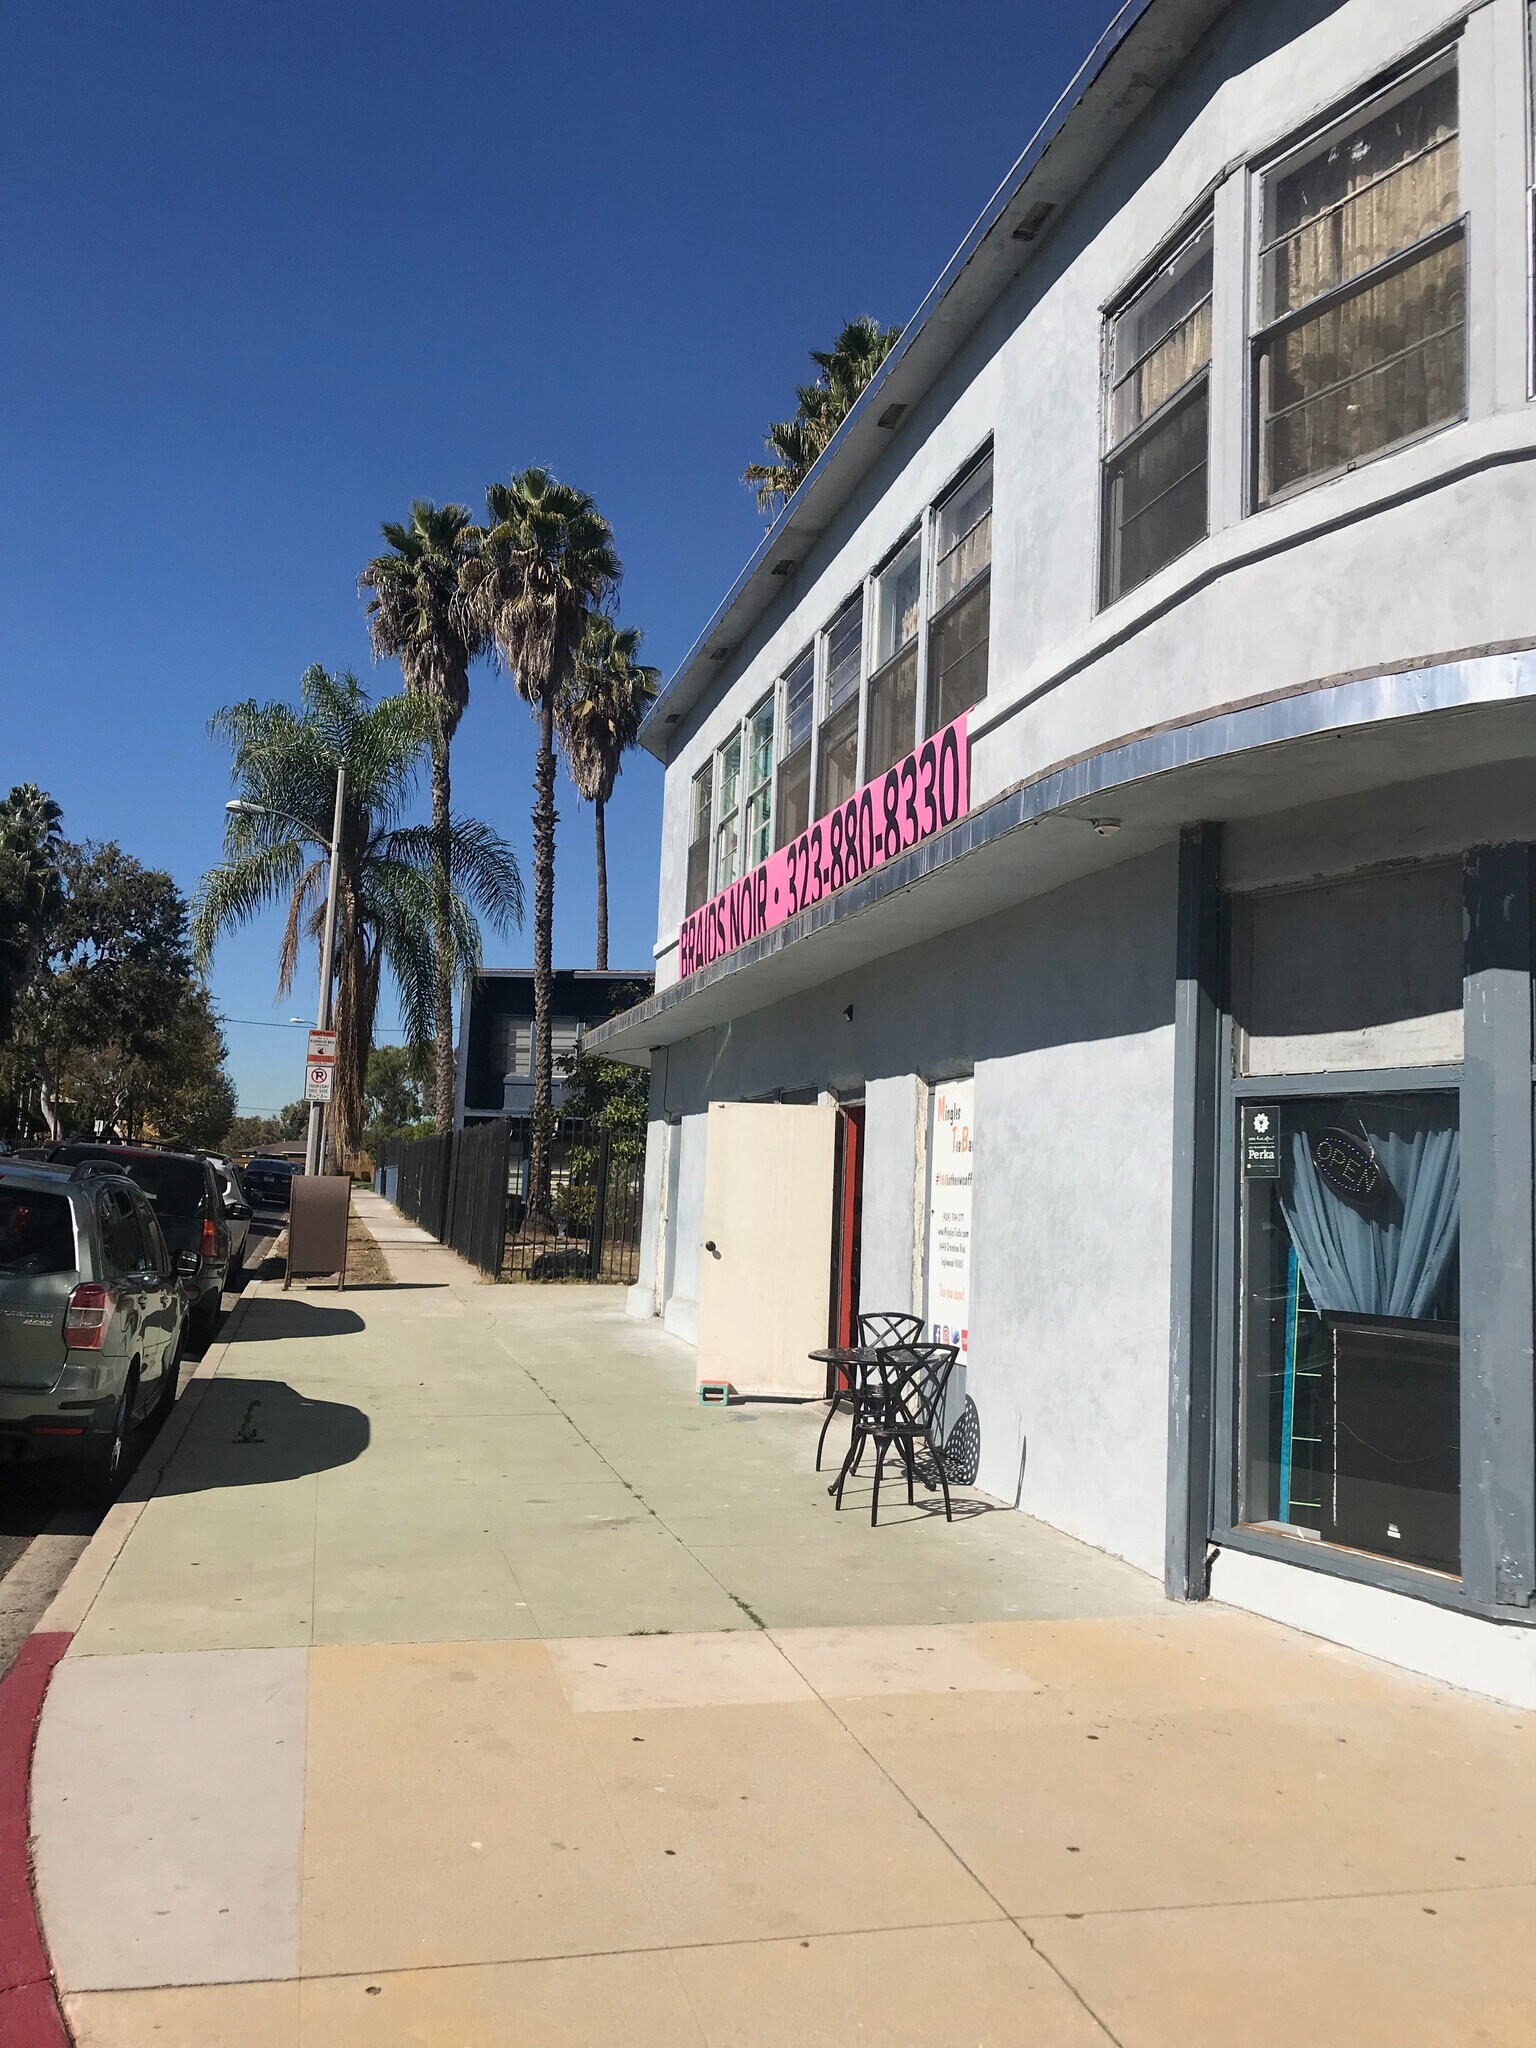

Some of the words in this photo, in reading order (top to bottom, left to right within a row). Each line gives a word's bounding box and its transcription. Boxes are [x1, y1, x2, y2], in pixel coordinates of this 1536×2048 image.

[680, 894, 726, 979] BRAIDS
[728, 865, 768, 947] NOIR
[786, 725, 960, 918] 323-880-8330
[938, 1095, 961, 1126] Mingles
[1248, 1149, 1275, 1159] Perka
[1317, 1141, 1377, 1193] OPEN
